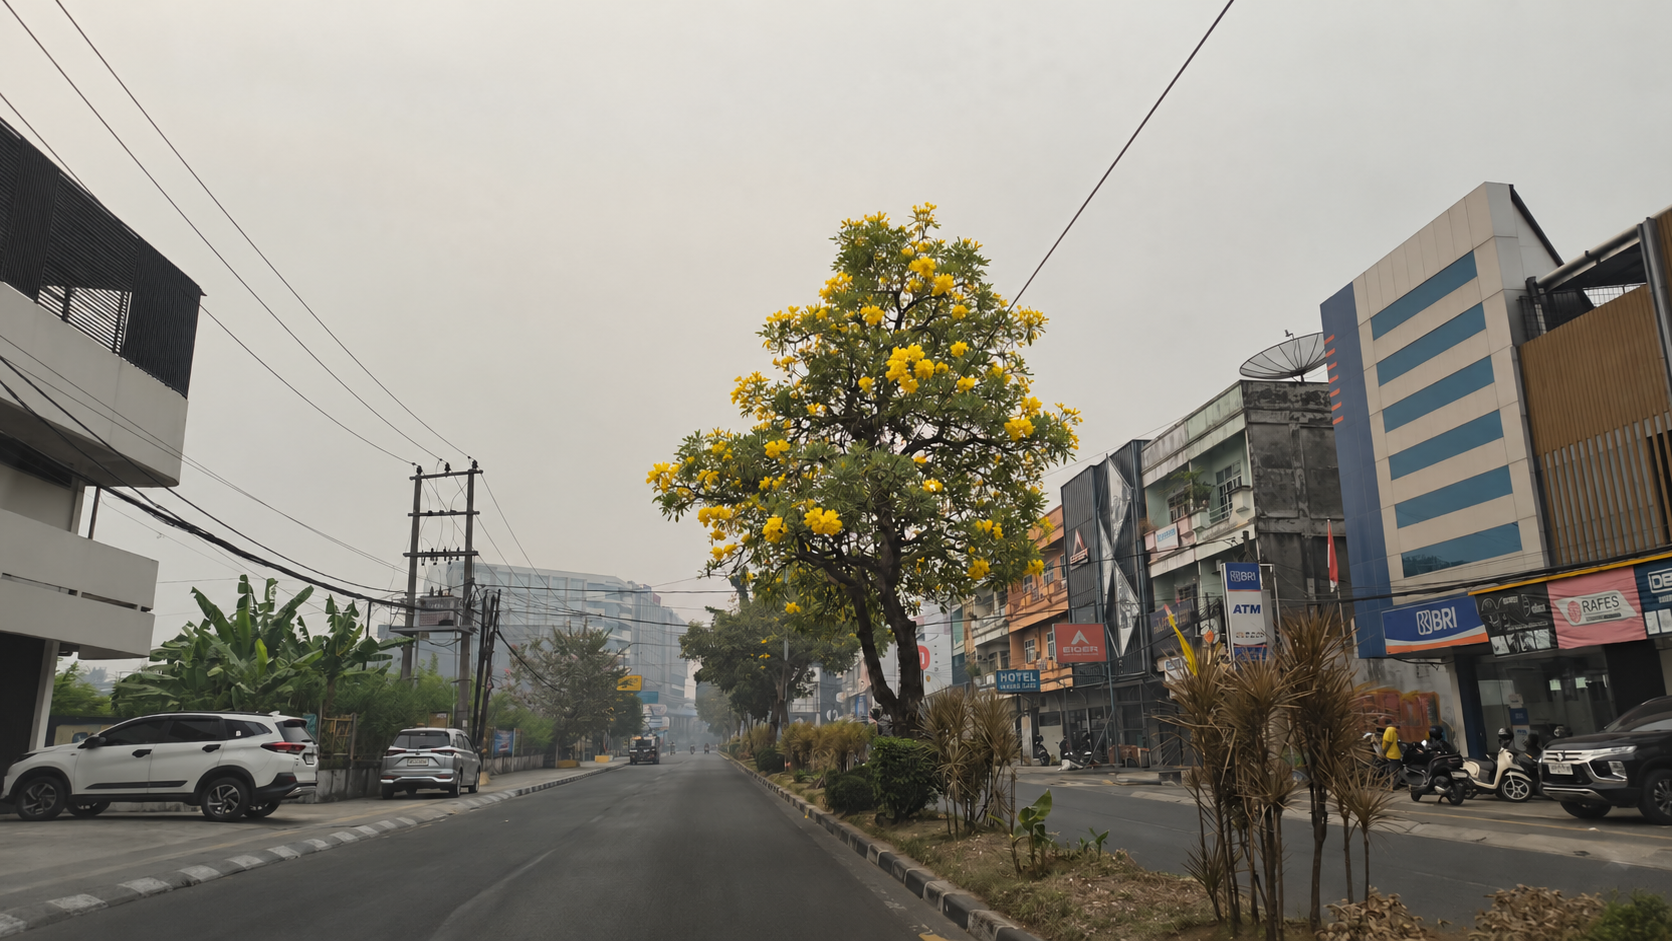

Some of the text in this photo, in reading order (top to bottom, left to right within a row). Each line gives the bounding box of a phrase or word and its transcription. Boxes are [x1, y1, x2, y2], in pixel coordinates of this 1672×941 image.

[1240, 571, 1256, 581] BRI
[1232, 604, 1261, 614] ATM
[1581, 596, 1620, 613] RAFES
[1431, 606, 1458, 631] BRI
[1000, 672, 1037, 683] HOTEL
